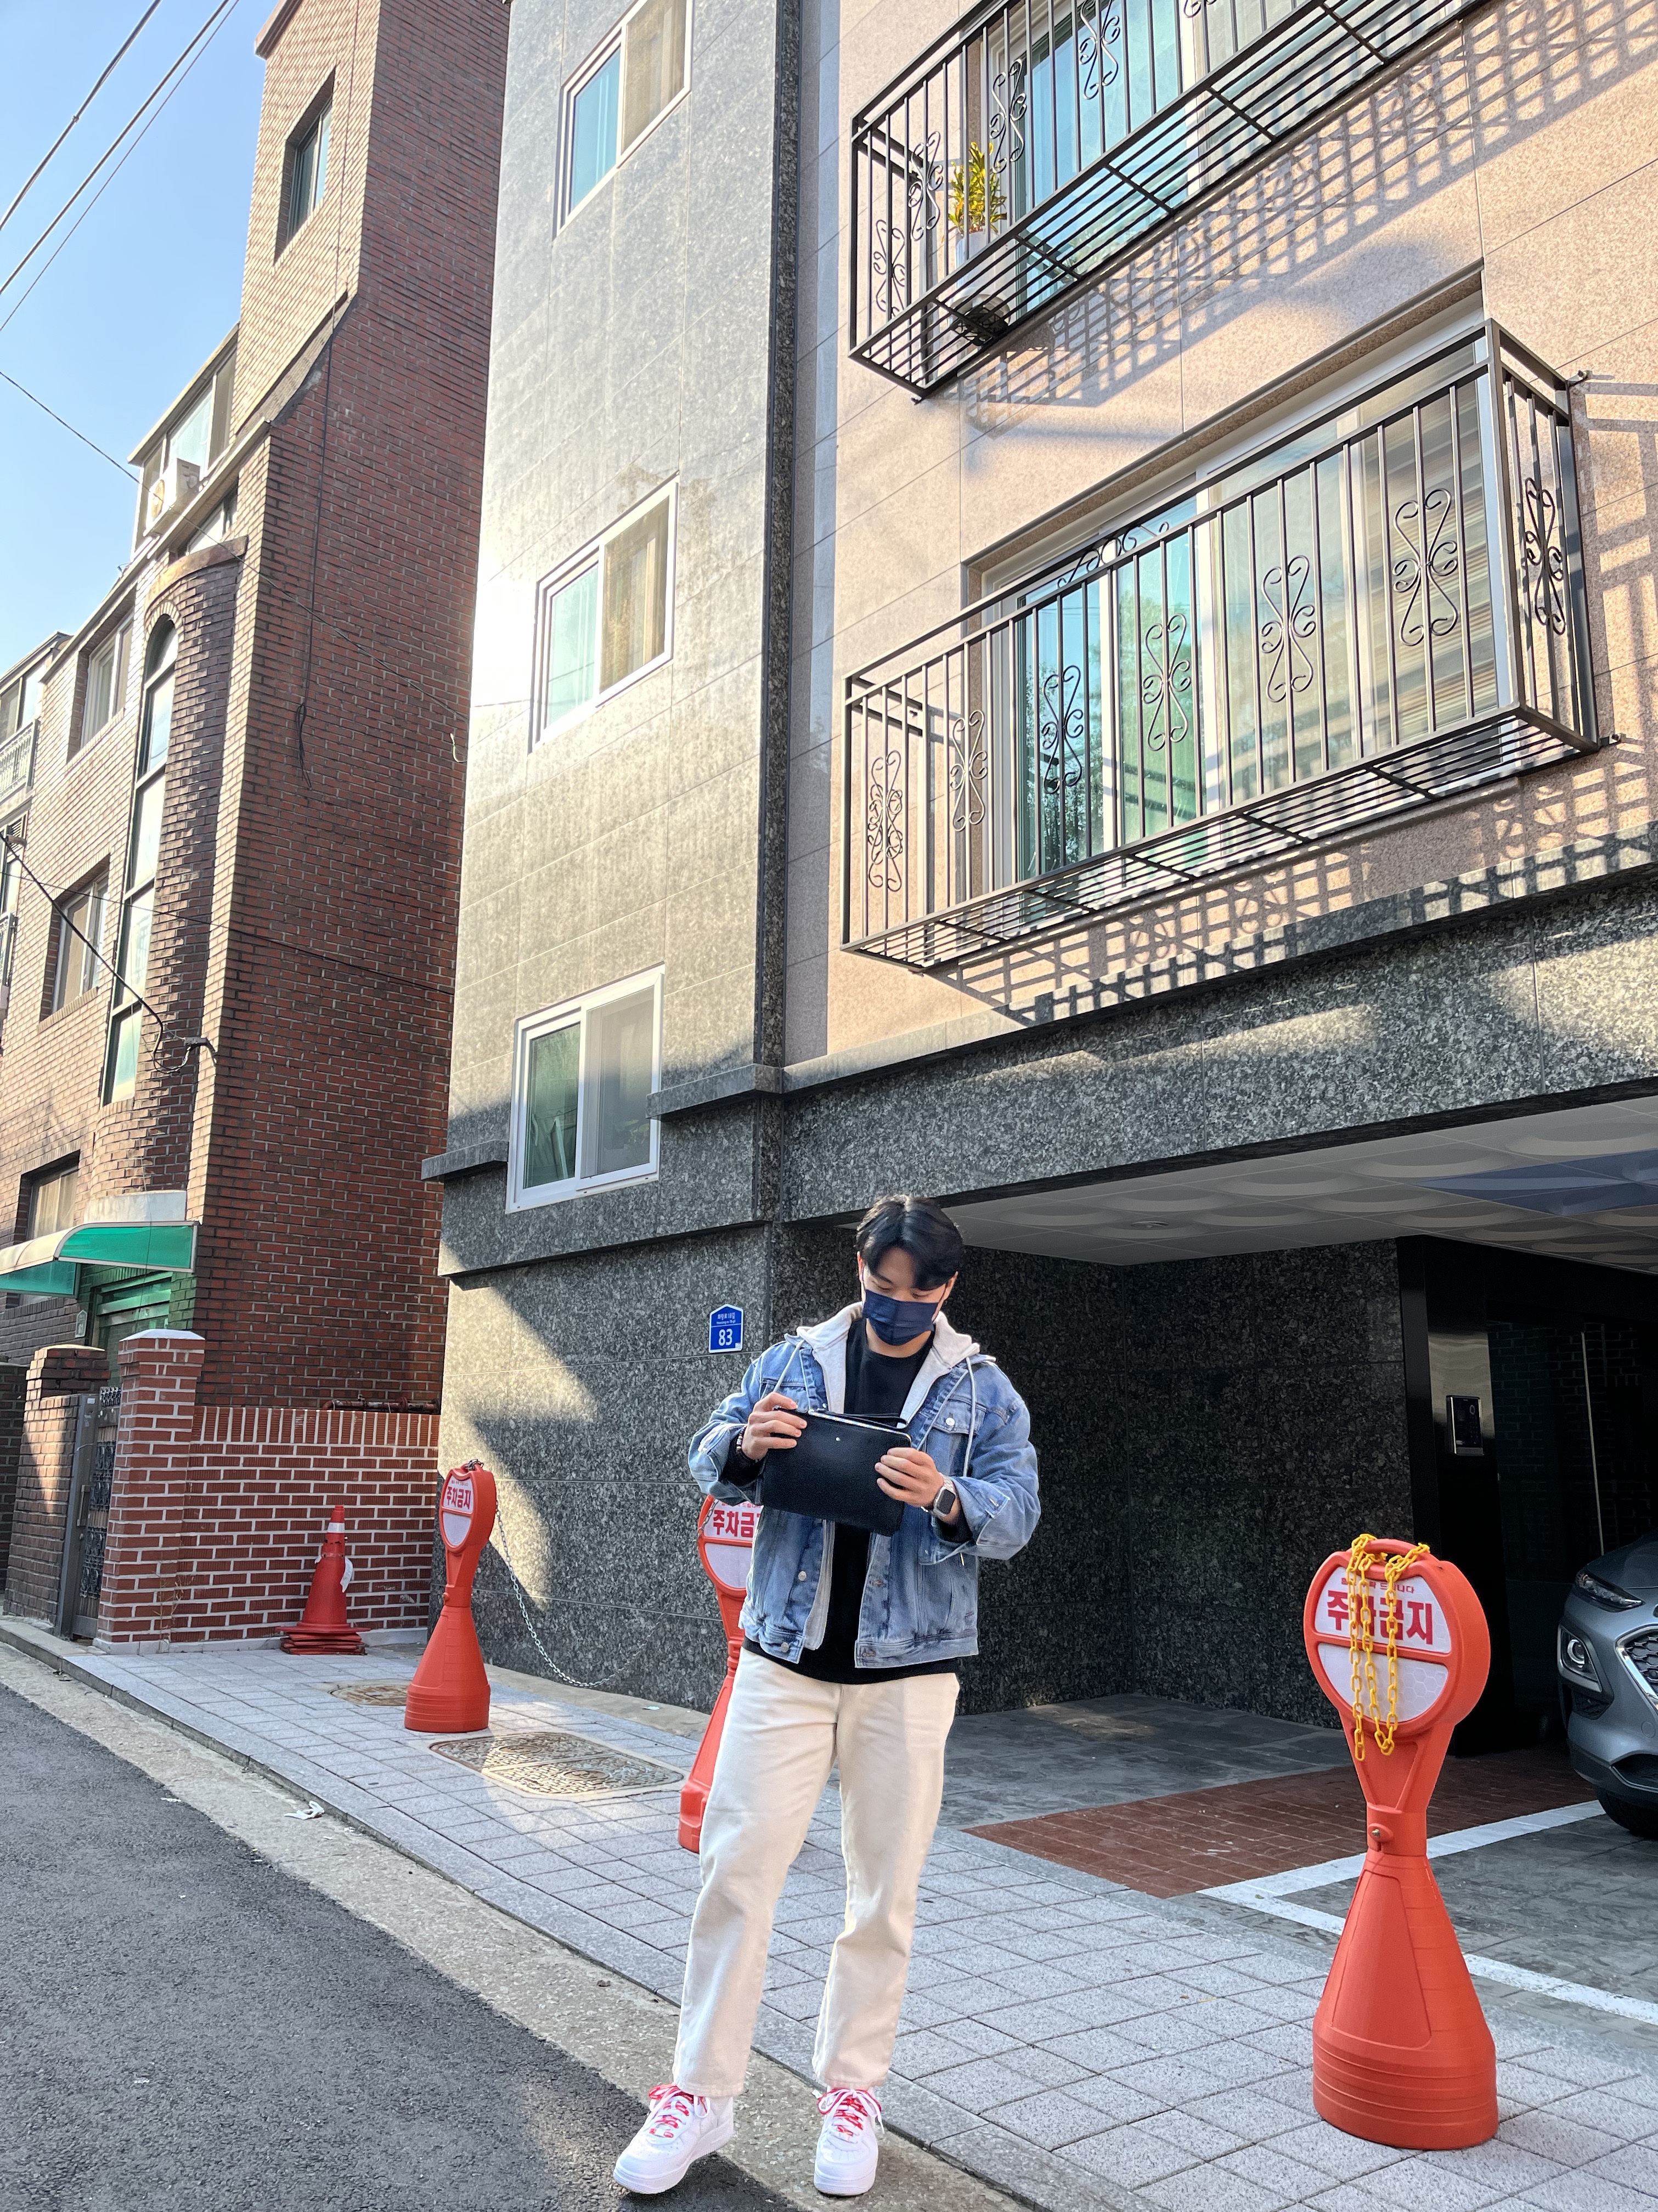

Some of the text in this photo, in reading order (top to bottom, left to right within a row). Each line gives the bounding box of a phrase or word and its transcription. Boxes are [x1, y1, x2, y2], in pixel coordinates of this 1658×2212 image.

[718, 1328, 733, 1346] 83
[447, 1486, 471, 1509] 주차금지
[713, 1510, 762, 1538] 주차금
[1380, 1582, 1414, 1594] 드니다
